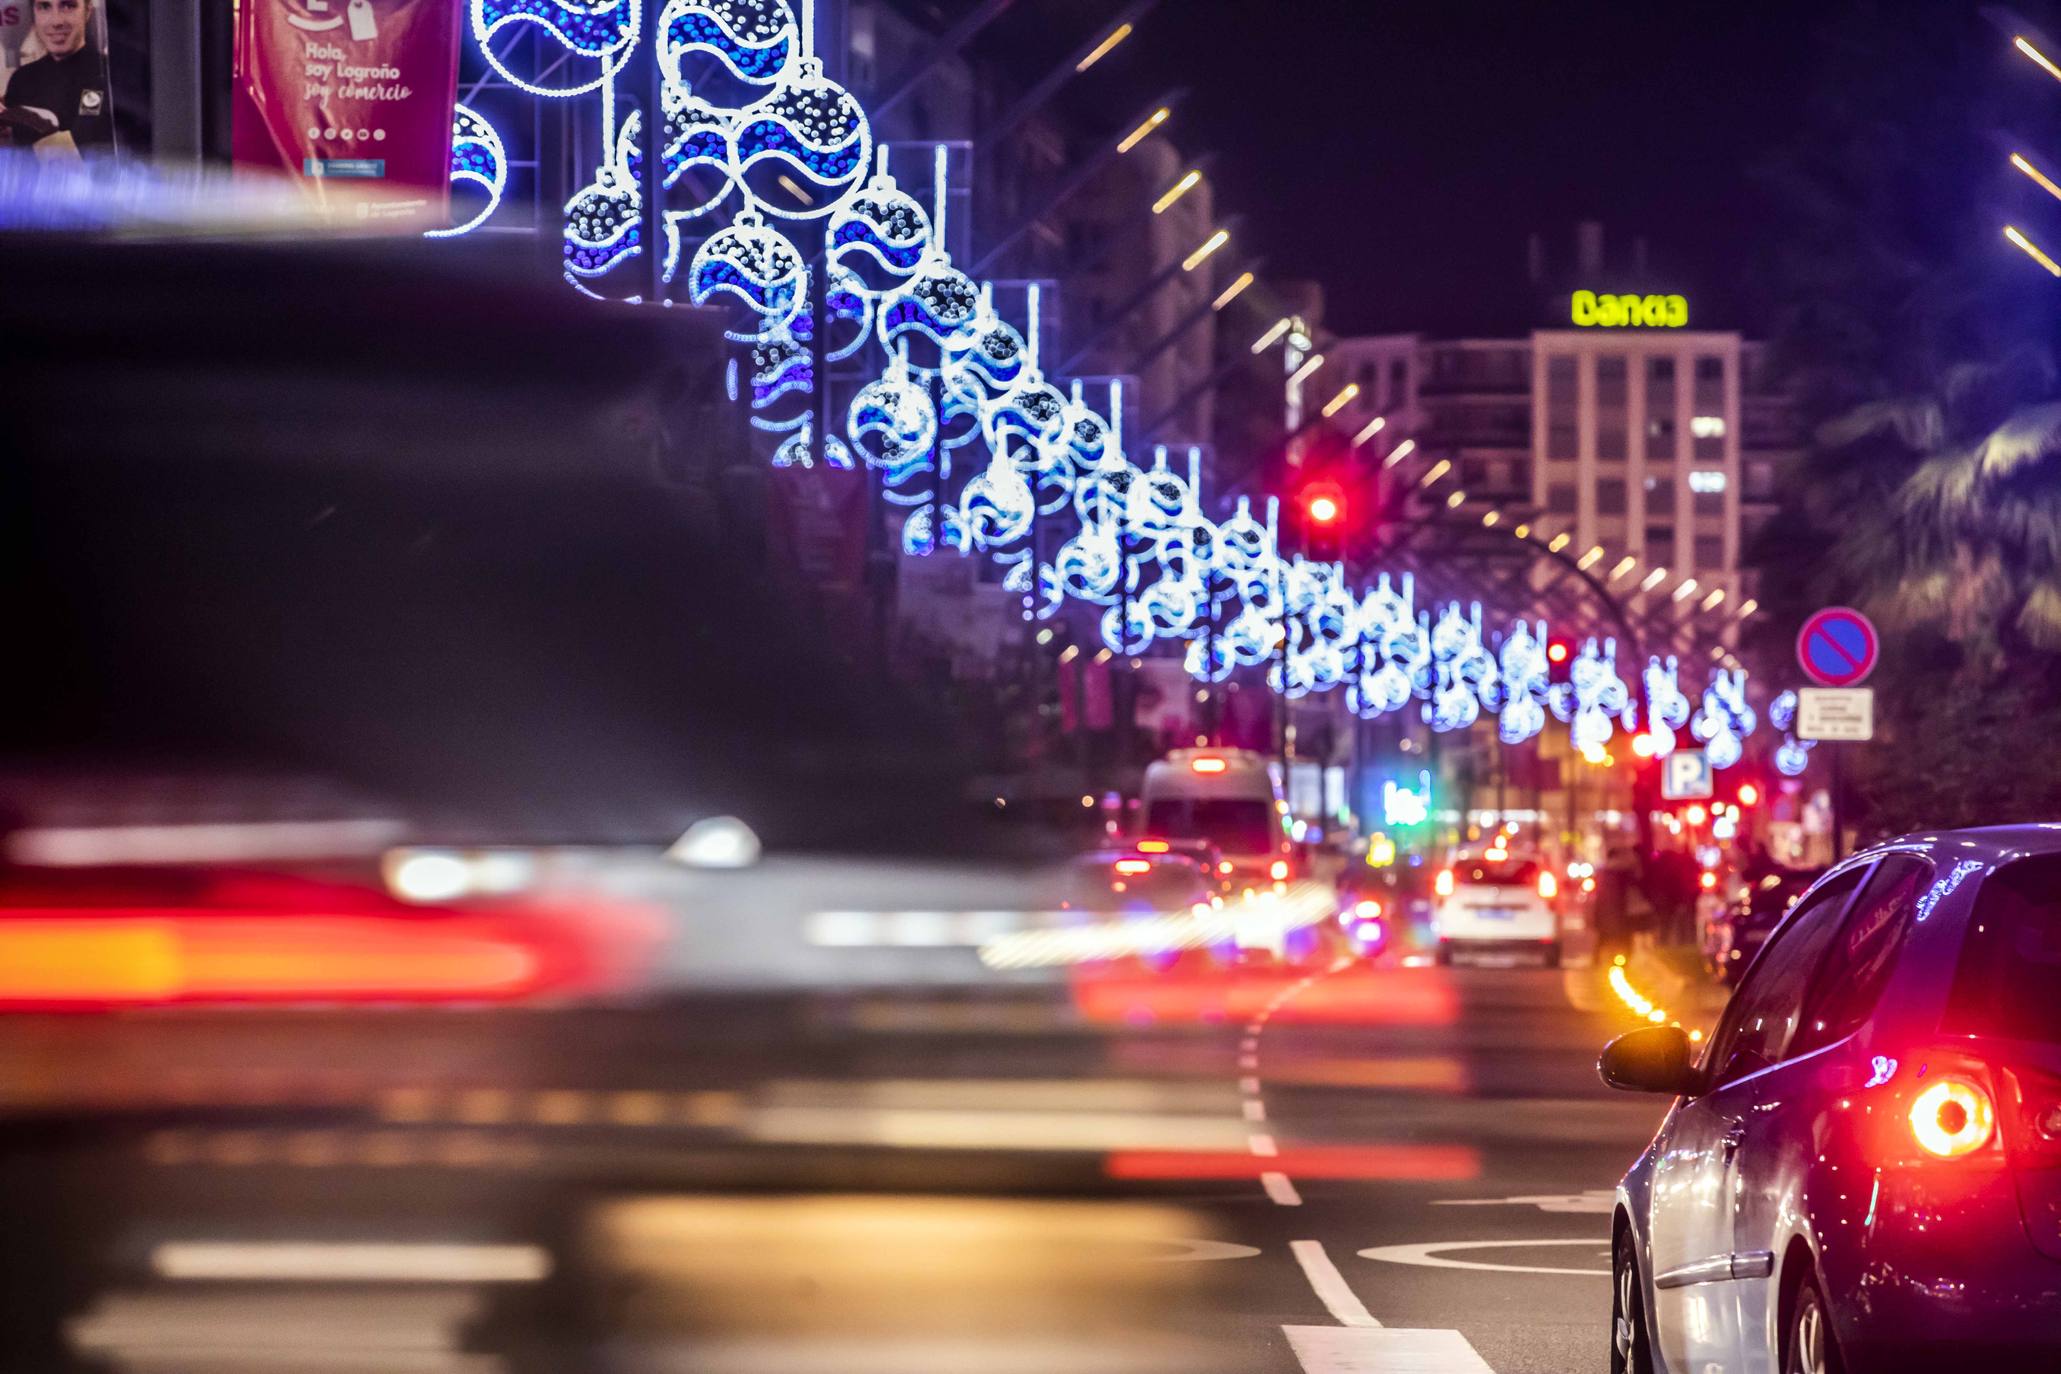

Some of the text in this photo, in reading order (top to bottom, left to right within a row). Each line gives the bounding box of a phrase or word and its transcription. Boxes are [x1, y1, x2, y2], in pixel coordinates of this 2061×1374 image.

[305, 42, 347, 61] Hola,
[305, 62, 400, 82] soy Logroño
[338, 82, 413, 101] comercio
[1671, 752, 1702, 795] P
